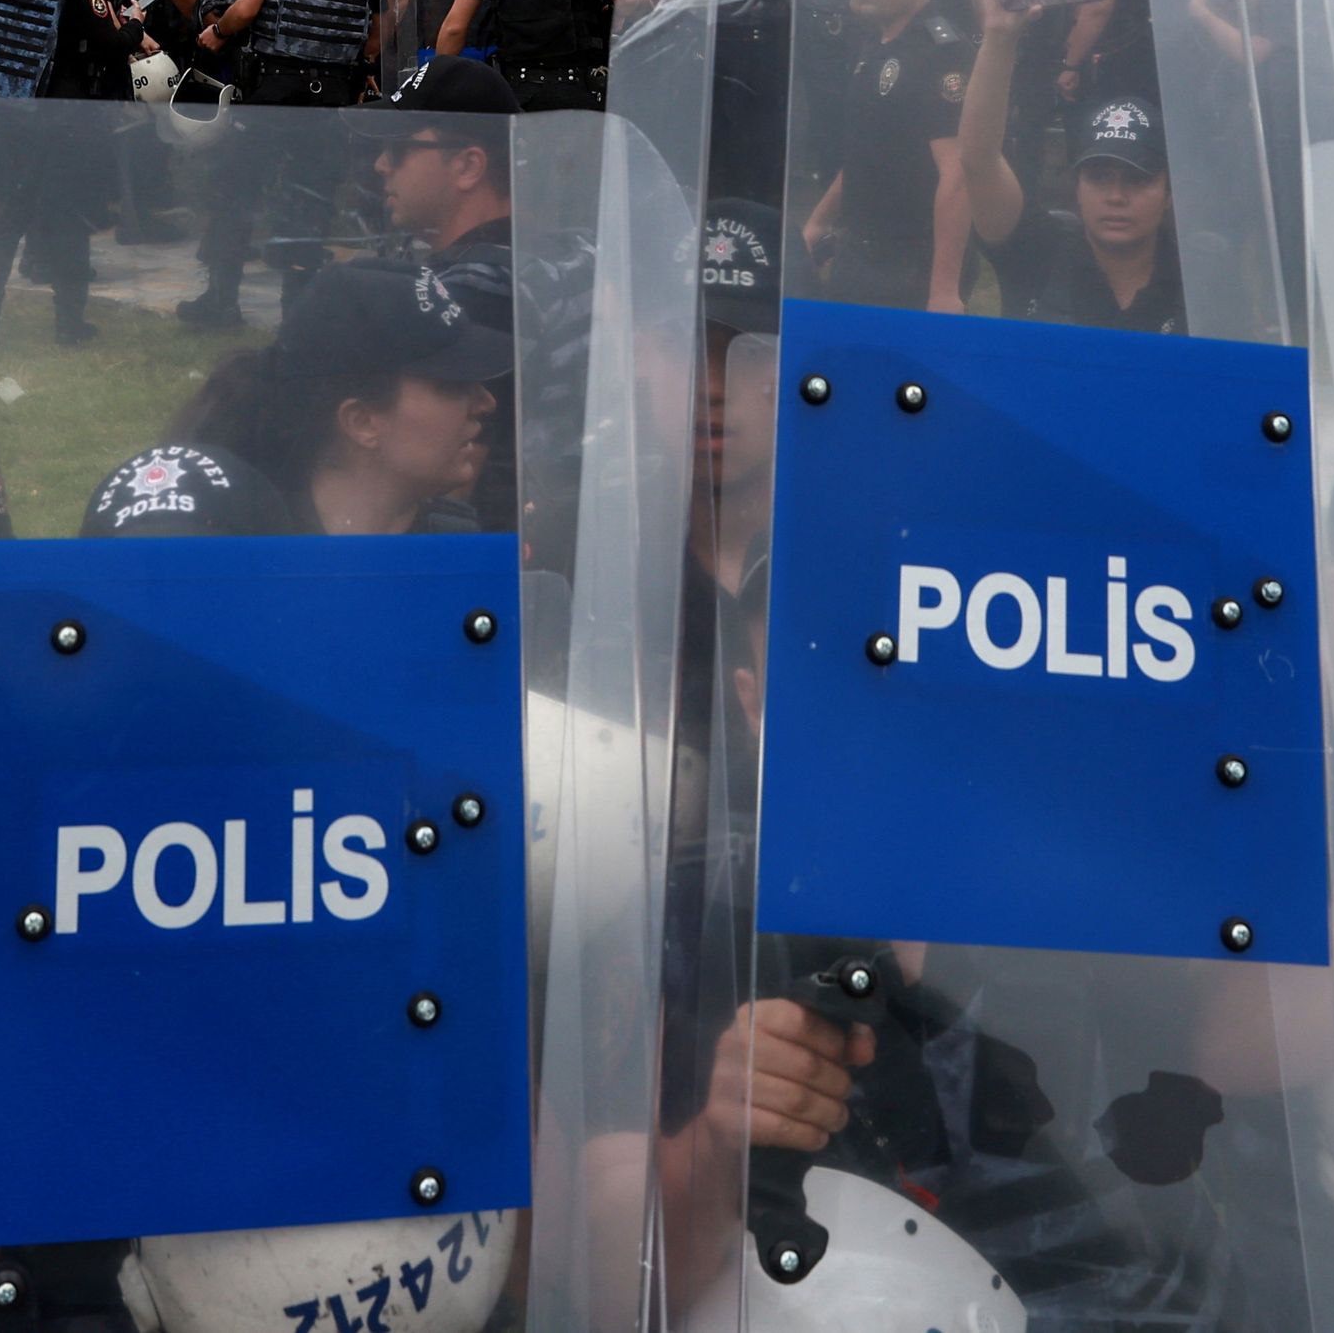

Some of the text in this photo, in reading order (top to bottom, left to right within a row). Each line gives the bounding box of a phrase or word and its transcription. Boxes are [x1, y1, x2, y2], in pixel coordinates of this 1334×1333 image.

[1095, 129, 1137, 141] POLİS
[717, 218, 769, 266] KUVVET
[685, 268, 755, 286] OLİS
[151, 446, 230, 488] KUVVET
[115, 490, 195, 527] POLİS
[897, 555, 1195, 682] POLİS
[54, 788, 389, 935] POLİS
[284, 1209, 503, 1333] 124212
